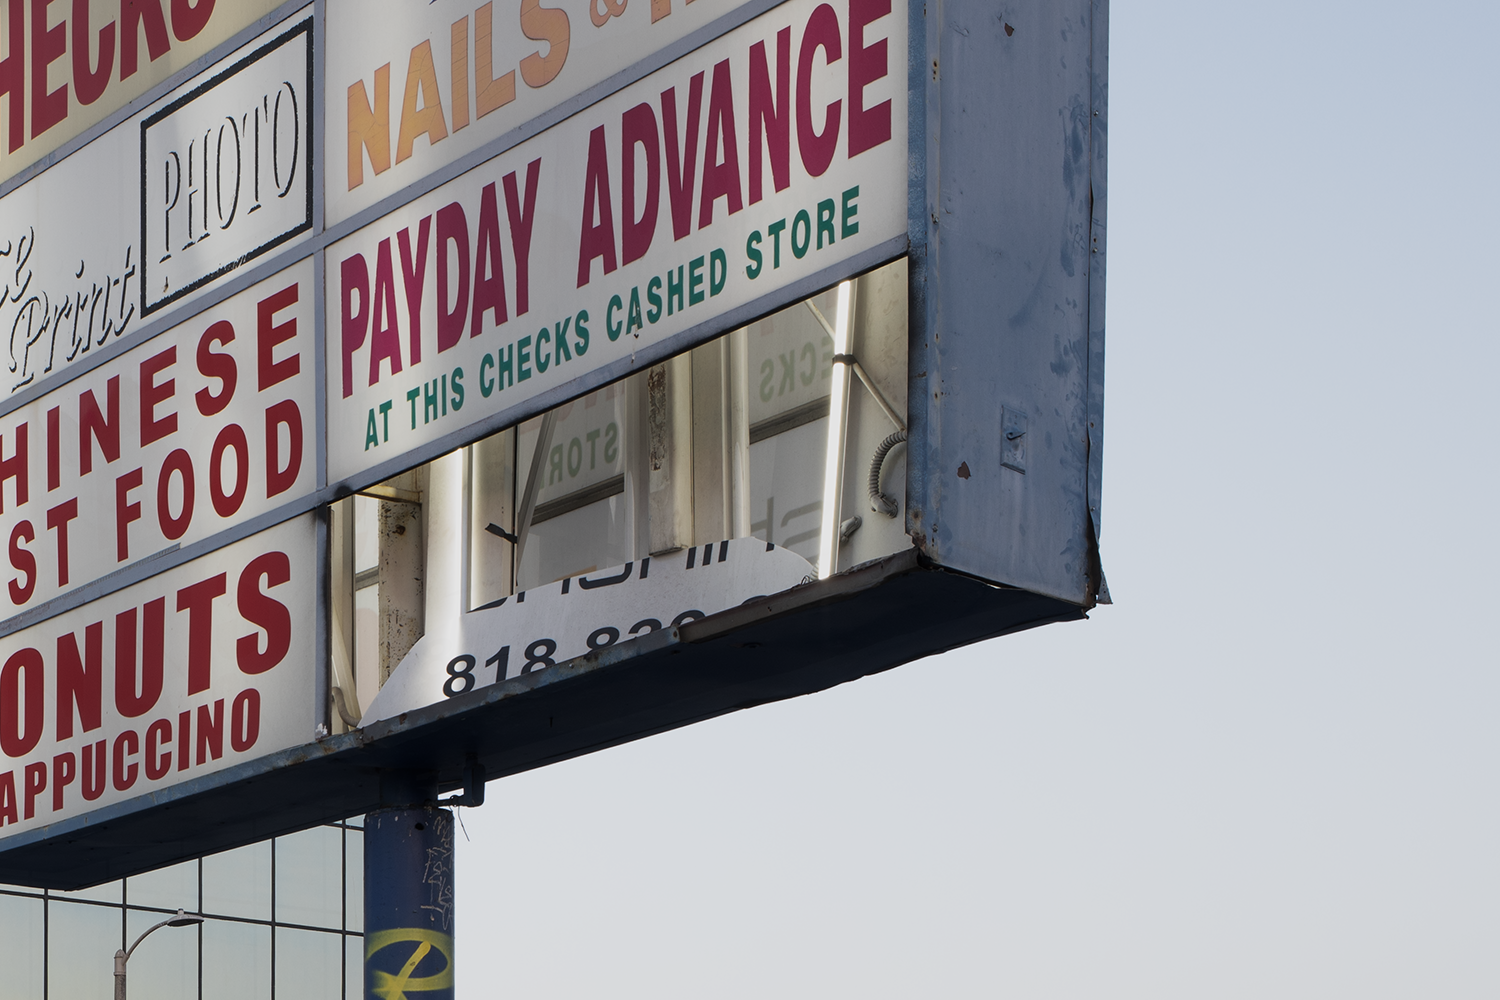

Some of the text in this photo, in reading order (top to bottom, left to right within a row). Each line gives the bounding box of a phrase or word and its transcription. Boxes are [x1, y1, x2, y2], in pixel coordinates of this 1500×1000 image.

[159, 82, 298, 263] PHOTO
[347, 0, 570, 192] NAILS
[341, 0, 892, 399] PAYDAY ADVANCE
[9, 246, 136, 393] Print
[364, 184, 860, 452] AT THIS CHECKS CASHED STORE
[117, 398, 304, 563] FOOD
[442, 638, 557, 699] 818
